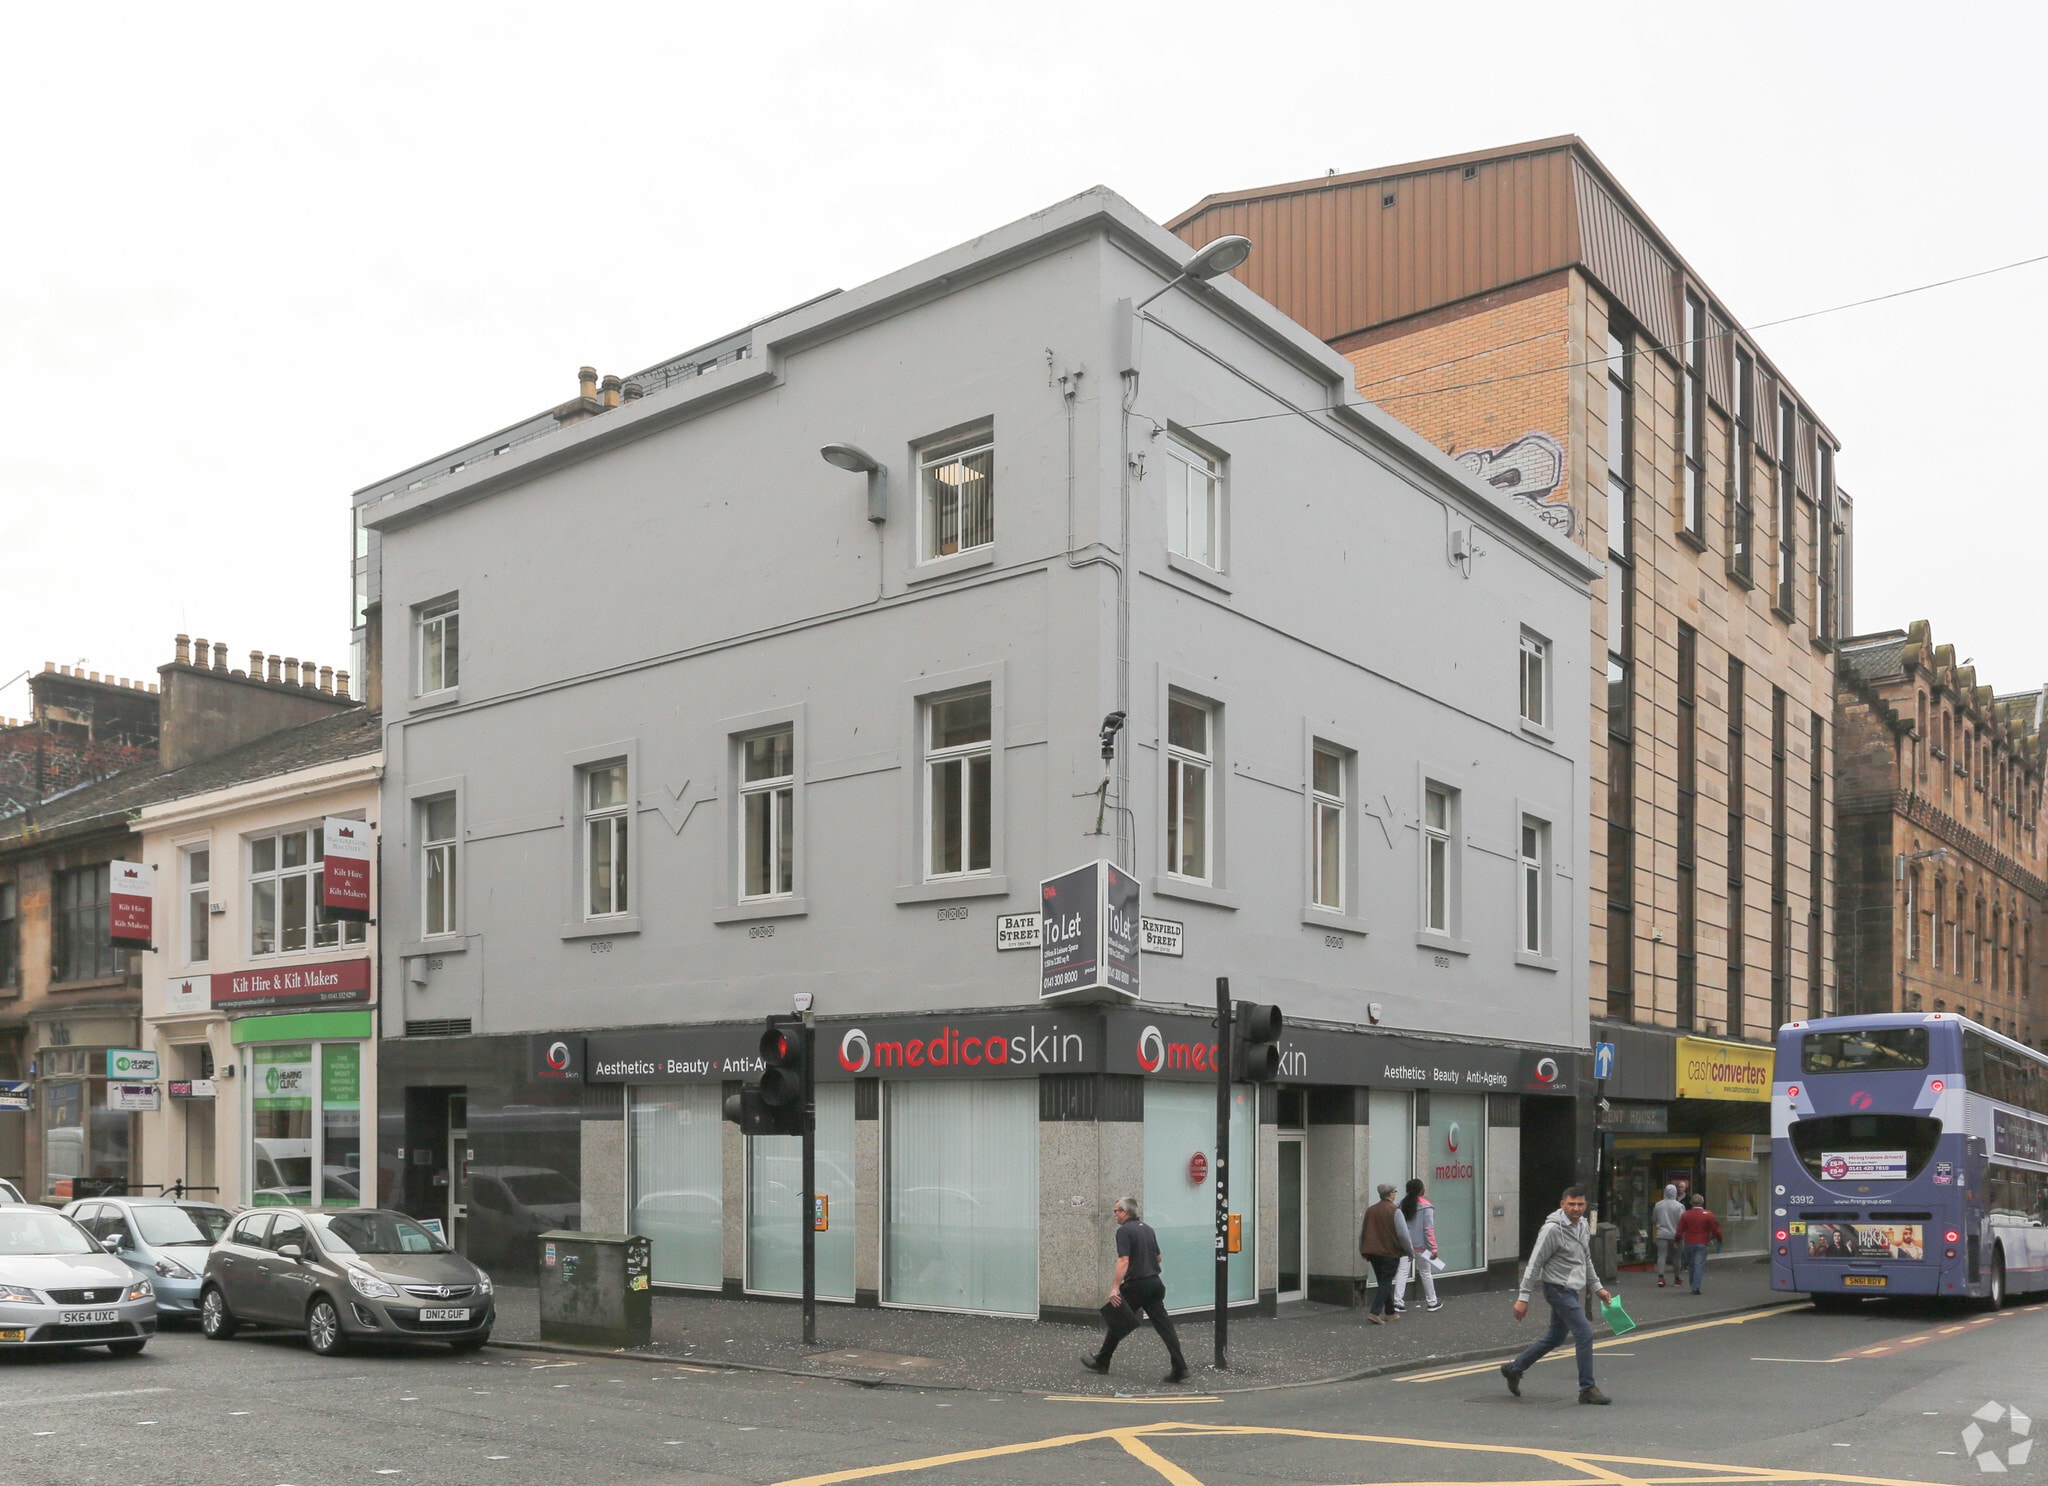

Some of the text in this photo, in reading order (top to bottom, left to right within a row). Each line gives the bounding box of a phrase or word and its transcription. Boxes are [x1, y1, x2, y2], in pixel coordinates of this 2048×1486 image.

[334, 868, 363, 879] Kilt Hire
[329, 888, 367, 899] Kilt Makers
[127, 922, 149, 930] Makers
[1005, 918, 1034, 928] BATH
[1044, 912, 1081, 945] To Let
[1108, 904, 1130, 941] To Let
[1143, 920, 1180, 935] RENFIELD
[1000, 929, 1040, 941] STREET
[1147, 932, 1176, 946] STREET
[233, 970, 338, 993] Kilt Hire & Kilt Makers
[1044, 976, 1053, 988] 0141
[1054, 973, 1064, 986] 300
[1064, 970, 1078, 984] 8000
[596, 1058, 654, 1076] Aesthetics
[667, 1058, 709, 1076] Beauty
[280, 1071, 302, 1079] HEARING
[1384, 1064, 1508, 1087] Aesthetics Beauty Anti-Ageing
[280, 1080, 298, 1089] CLINIC
[1630, 1110, 1656, 1124] HOUSE
[1436, 1160, 1472, 1179] medica
[1790, 1196, 1814, 1204] 33912
[64, 1312, 115, 1322] SK64 UXC
[426, 1310, 464, 1319] DN12 GUF
